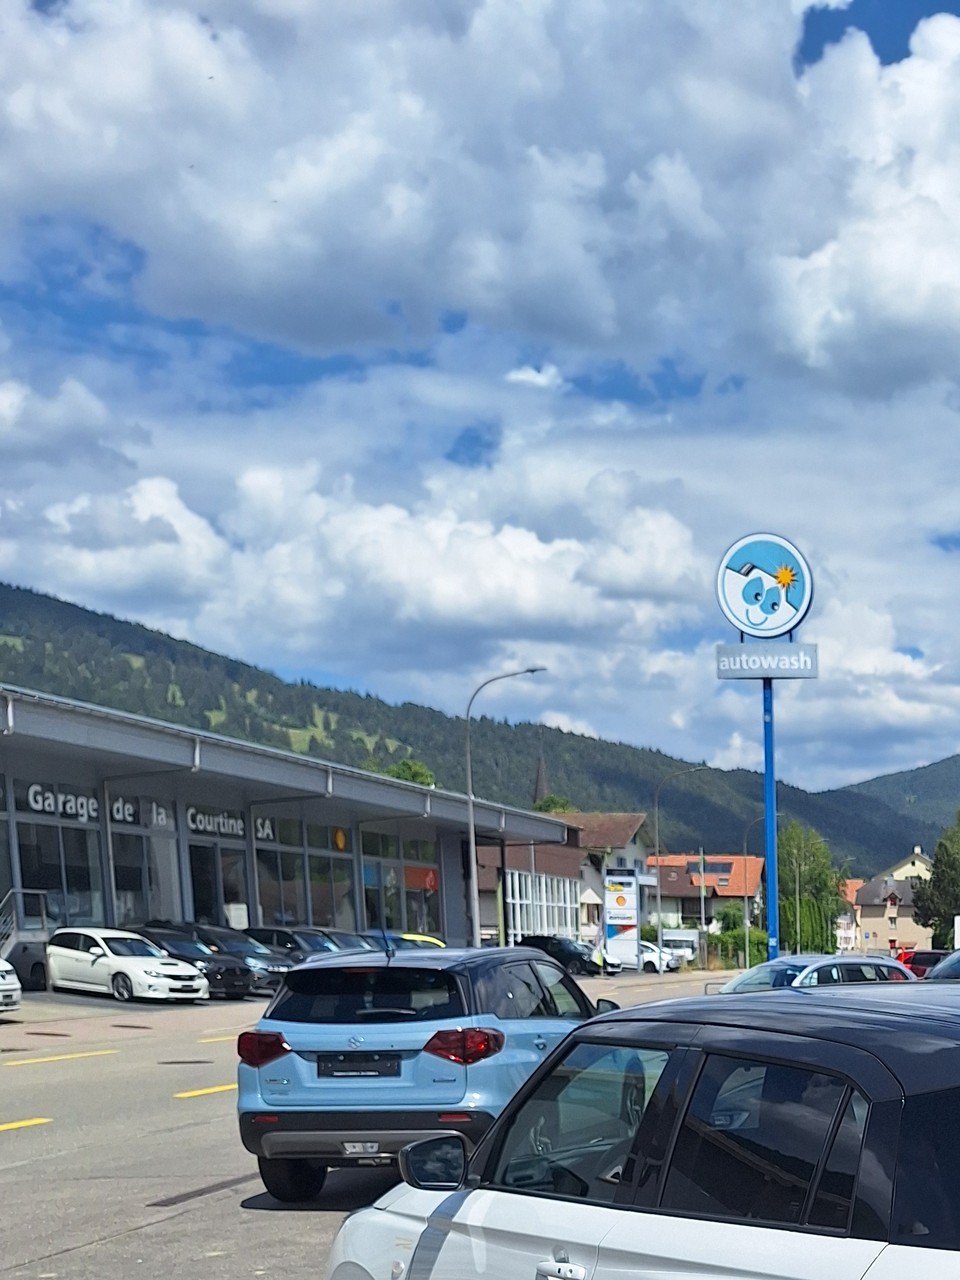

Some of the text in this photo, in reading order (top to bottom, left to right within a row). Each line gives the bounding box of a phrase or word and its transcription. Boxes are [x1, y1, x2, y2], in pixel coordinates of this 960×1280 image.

[719, 650, 812, 670] autowash
[28, 783, 274, 840] Garage de la Courtine SA
